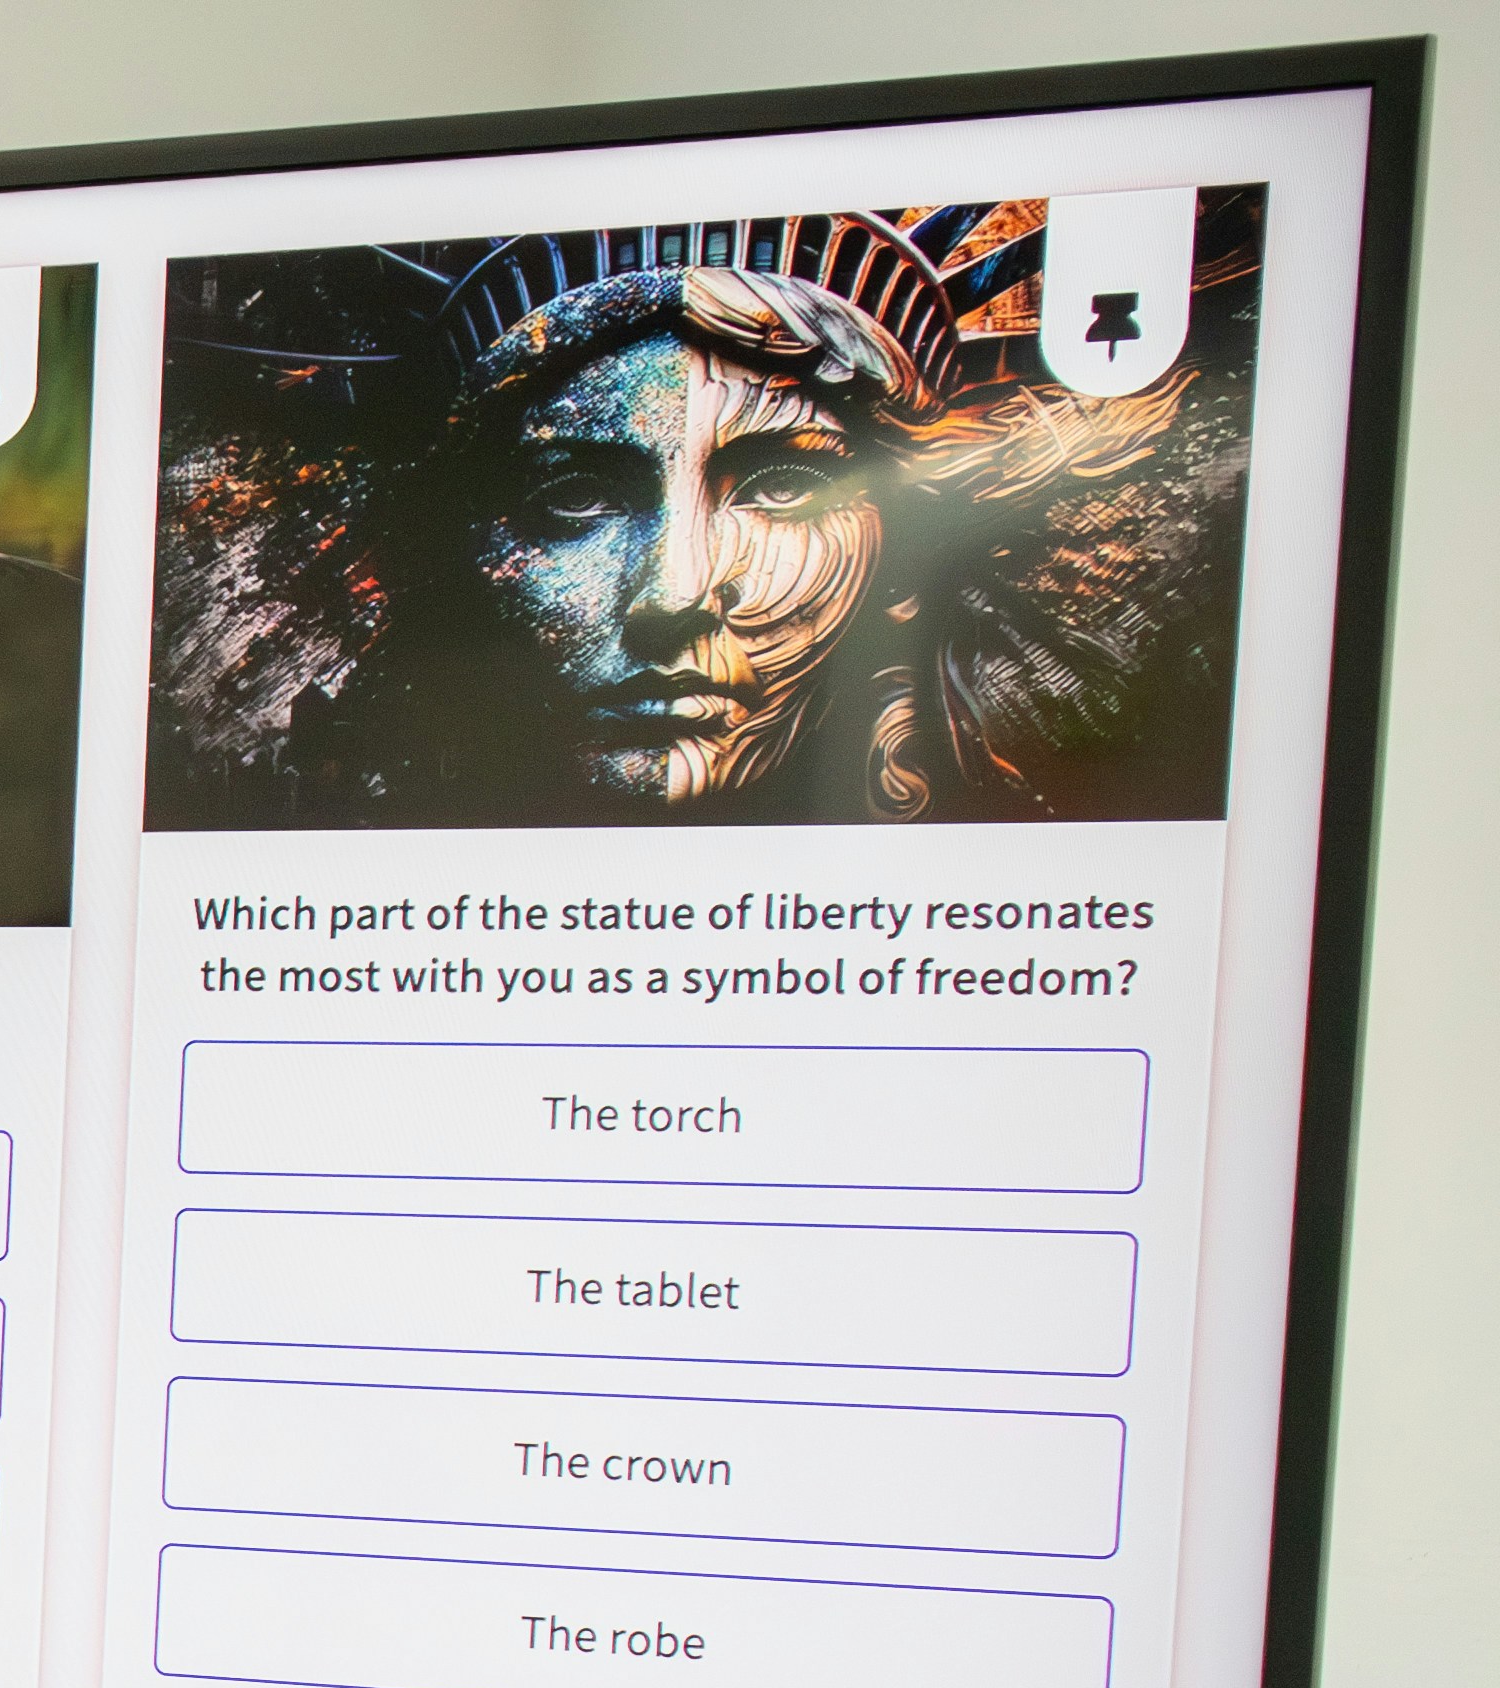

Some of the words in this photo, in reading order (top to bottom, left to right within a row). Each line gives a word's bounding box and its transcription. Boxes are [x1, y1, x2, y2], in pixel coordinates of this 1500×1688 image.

[193, 895, 316, 931] Which
[329, 898, 415, 940] part
[426, 894, 471, 931] of
[478, 894, 548, 931] the
[560, 897, 695, 931] statue
[708, 892, 755, 930] of
[765, 893, 913, 940] liberty
[926, 895, 1154, 930] resonates
[526, 1267, 603, 1305] The
[615, 1270, 740, 1310] tablet
[514, 1441, 590, 1479] The
[602, 1455, 731, 1486] crown
[521, 1614, 597, 1653] The
[611, 1621, 705, 1660] robe
